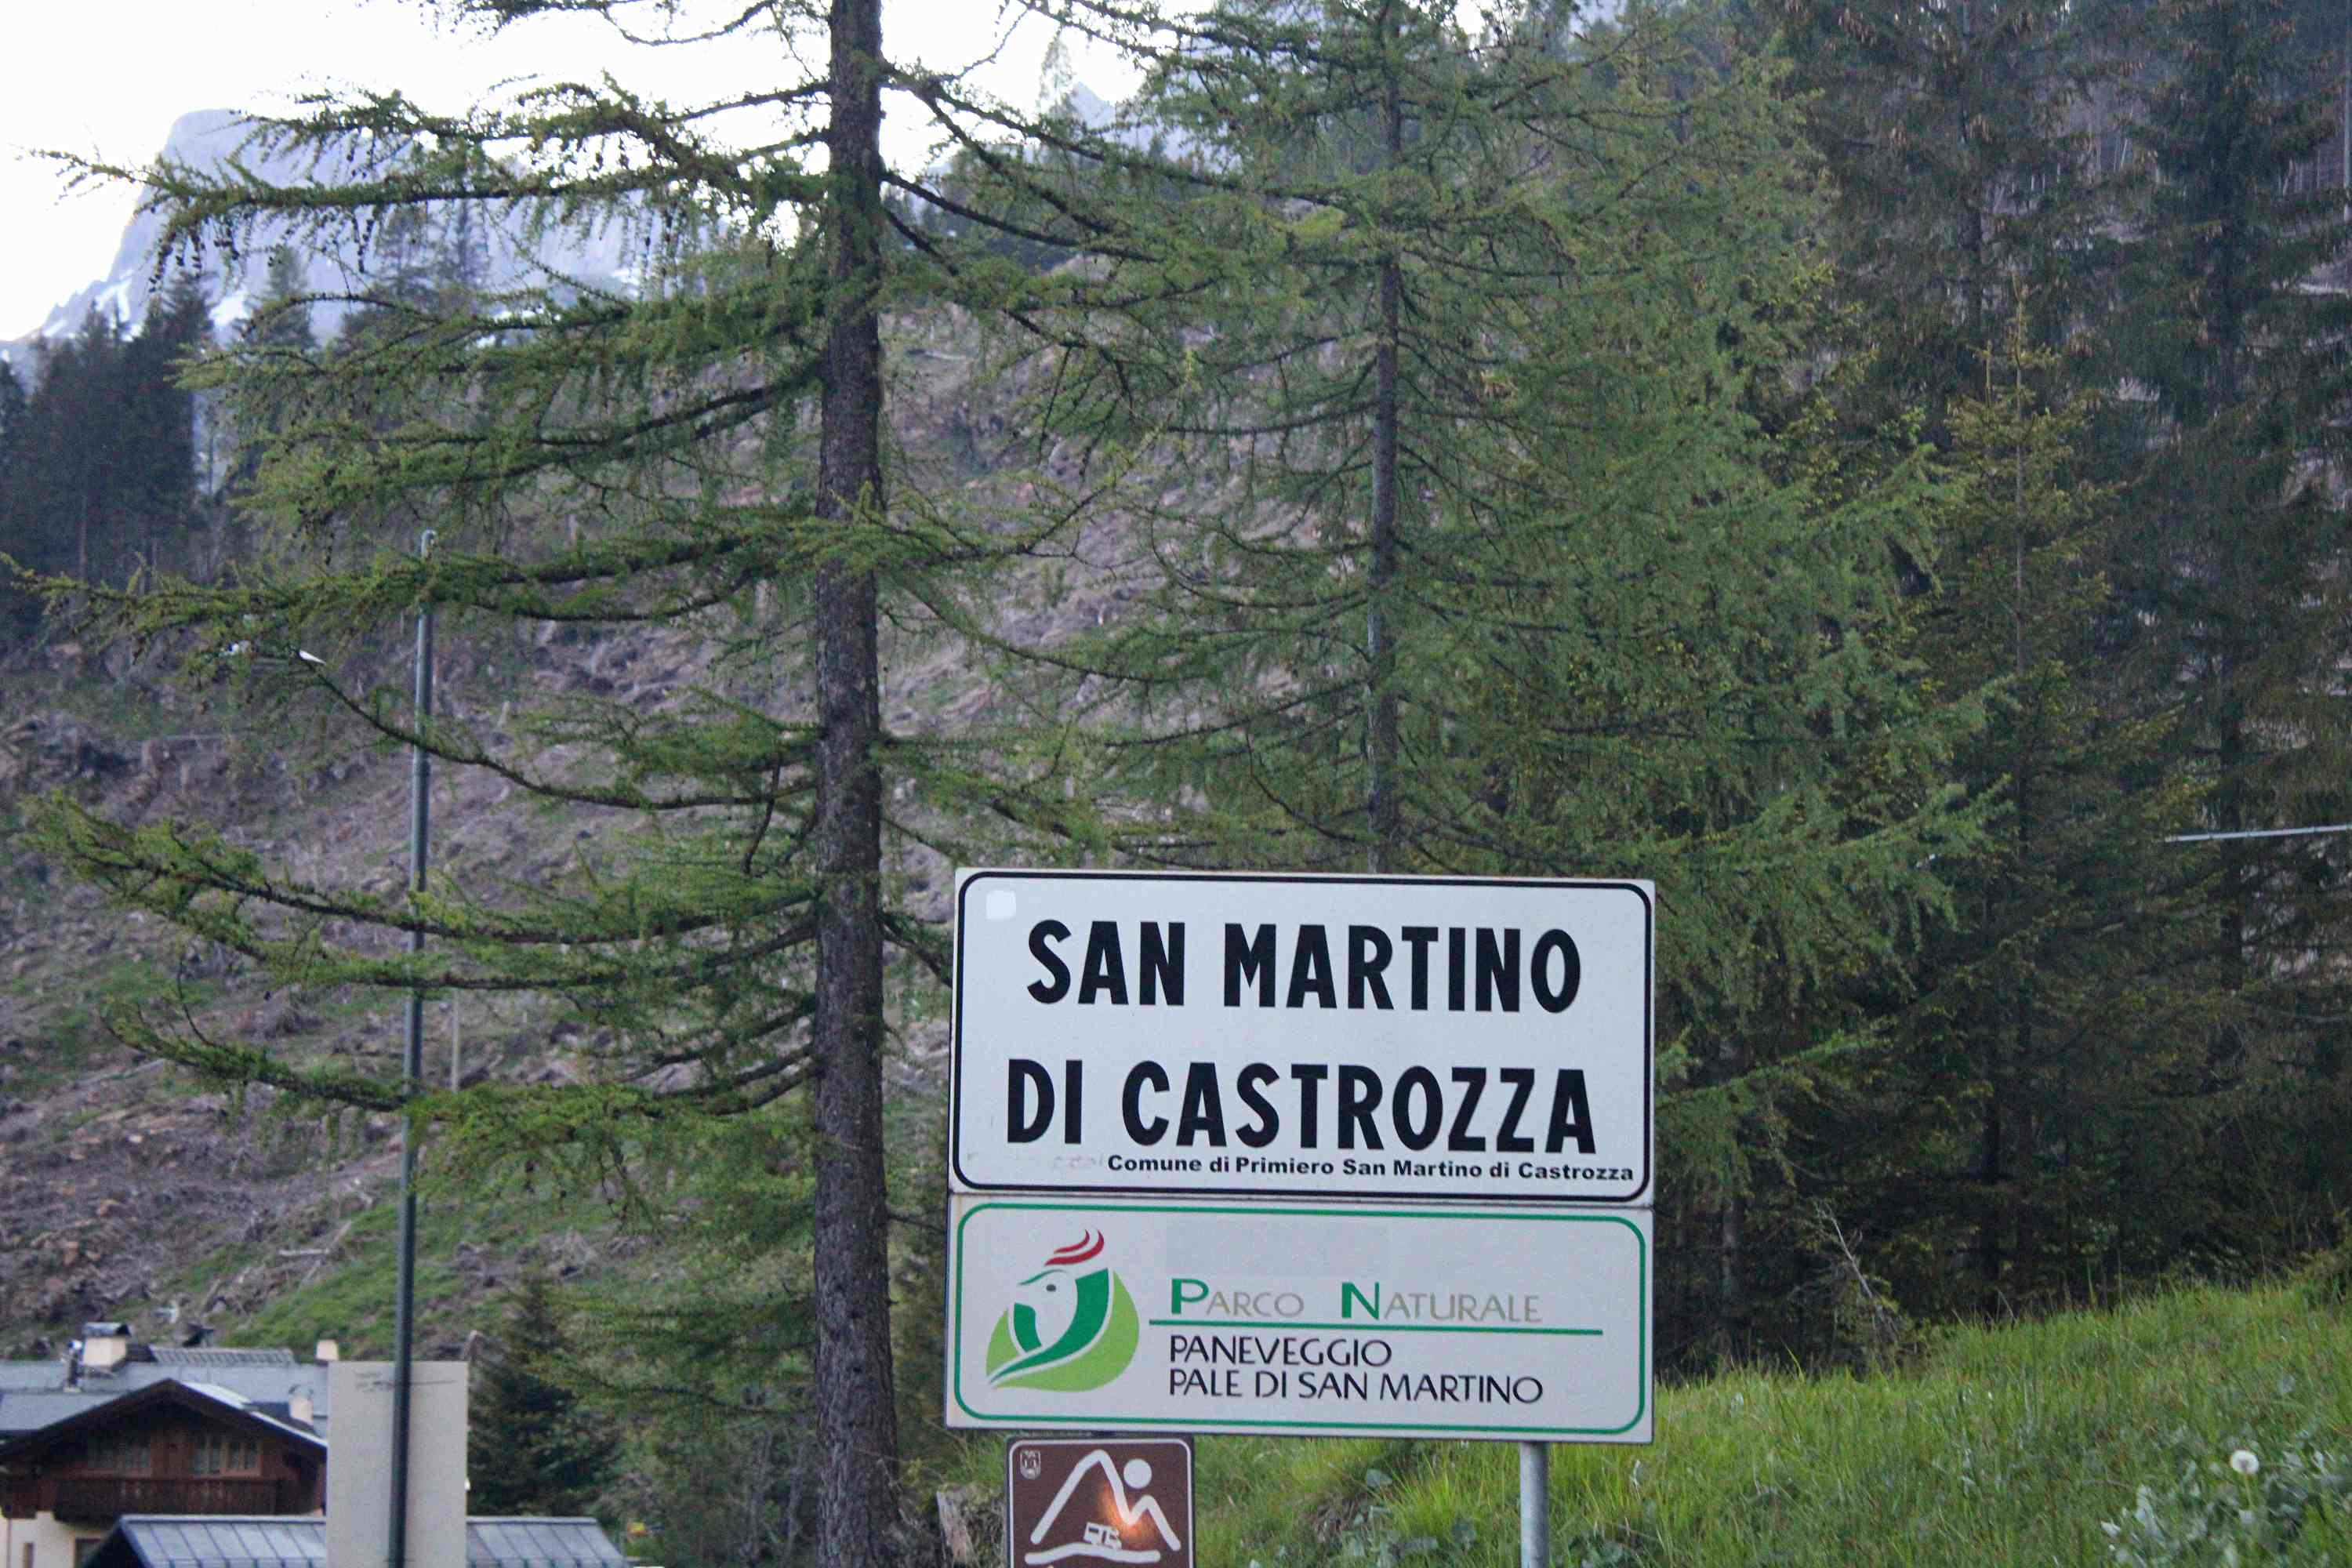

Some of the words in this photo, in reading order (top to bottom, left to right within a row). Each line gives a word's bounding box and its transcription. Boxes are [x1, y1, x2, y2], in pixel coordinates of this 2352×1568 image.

[1028, 920, 1185, 1007] SAN
[1224, 923, 1581, 1014] MARTINO
[1007, 1058, 1083, 1145] DI
[1122, 1061, 1596, 1155] CASTROZZA
[1107, 1154, 1202, 1172] Comune
[1209, 1156, 1230, 1173] di
[1236, 1156, 1334, 1175] Primiero
[1342, 1159, 1385, 1176] San
[1393, 1160, 1483, 1178] Martino
[1490, 1162, 1510, 1178] di
[1518, 1162, 1634, 1181] Castrozza
[1171, 1277, 1305, 1318] PARCO
[1341, 1281, 1543, 1323] NATURALE
[1170, 1335, 1392, 1367] PANEVEGGIO
[1170, 1369, 1243, 1398] PALE
[1255, 1370, 1287, 1399] DI
[1298, 1372, 1368, 1401] SAN
[1379, 1374, 1544, 1405] MARTINO
